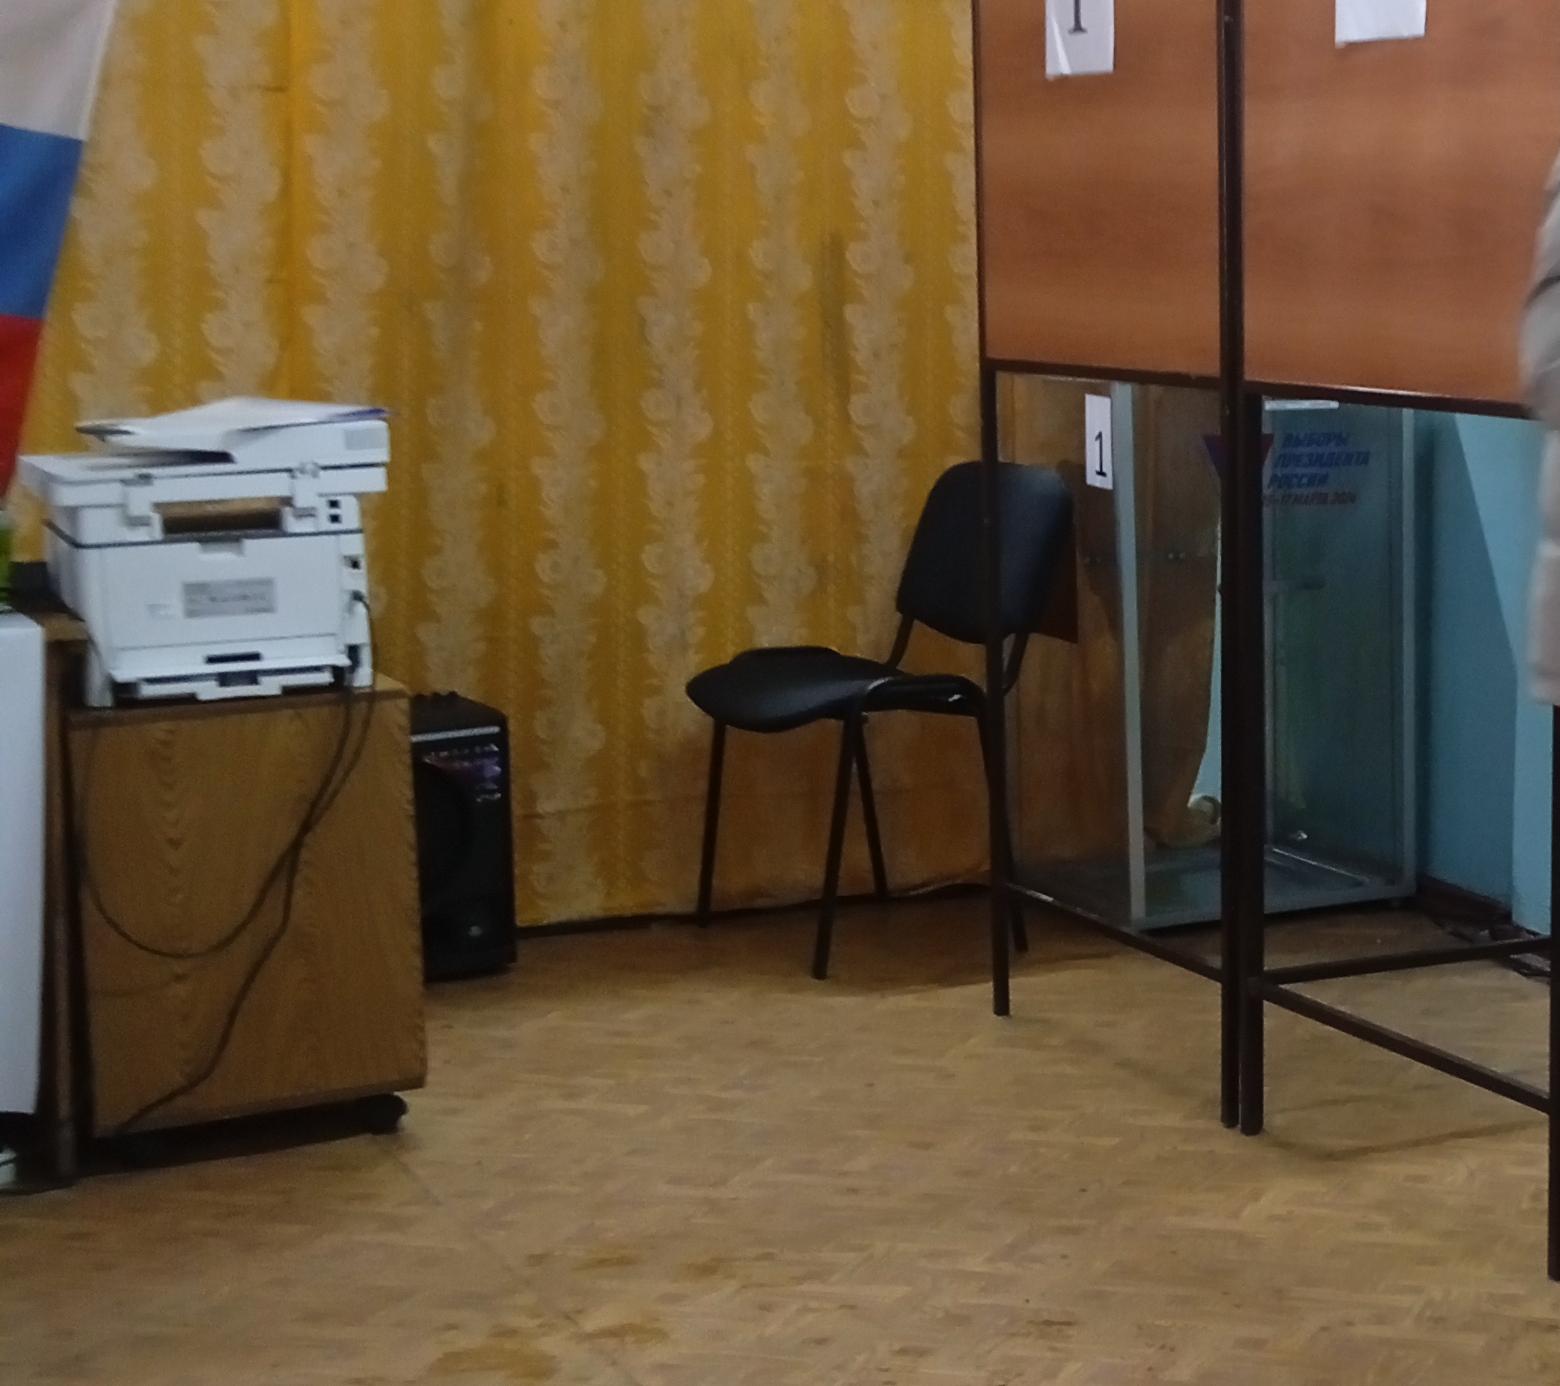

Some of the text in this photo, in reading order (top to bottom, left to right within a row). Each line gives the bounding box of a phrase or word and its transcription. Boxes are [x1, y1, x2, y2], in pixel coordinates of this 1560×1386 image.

[1283, 431, 1349, 448] ВЫБОРЫ
[1094, 430, 1108, 478] 1
[1274, 450, 1370, 468] ПРЕЗИДЕНТА
[1267, 472, 1330, 490] РОССИИ
